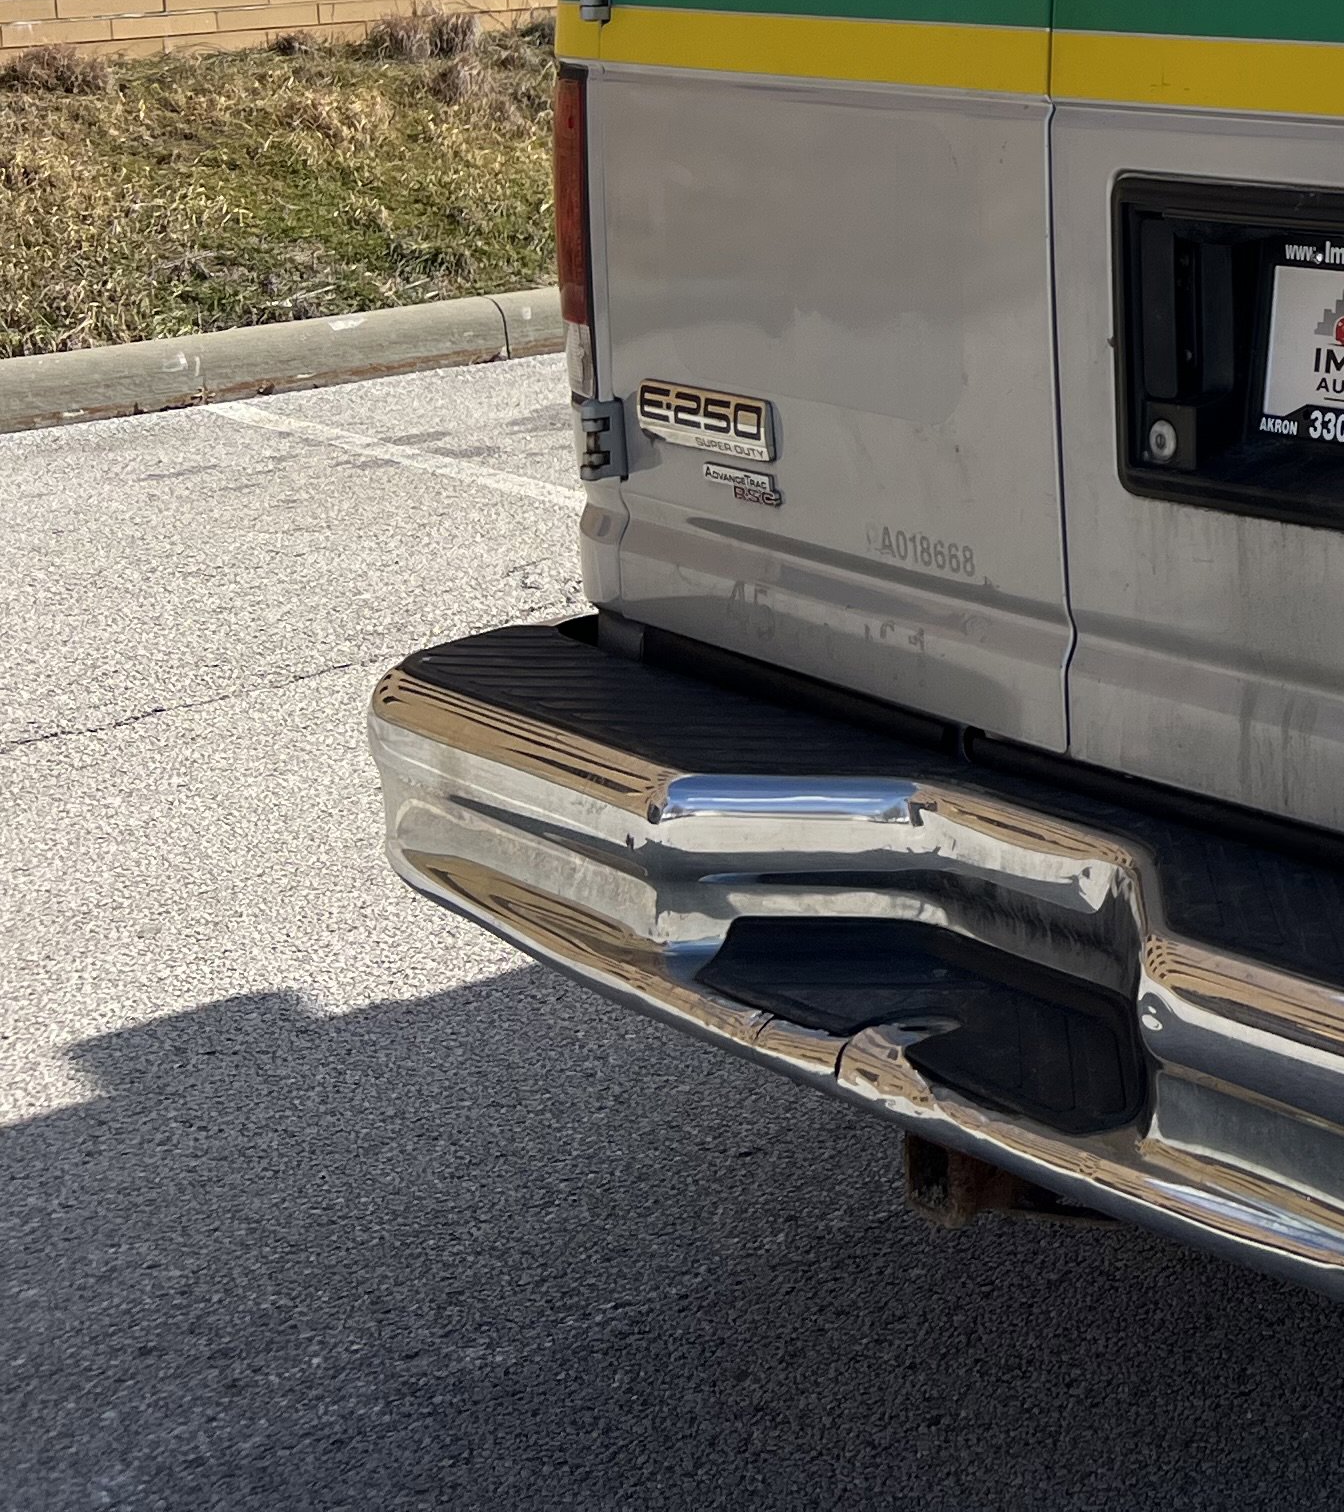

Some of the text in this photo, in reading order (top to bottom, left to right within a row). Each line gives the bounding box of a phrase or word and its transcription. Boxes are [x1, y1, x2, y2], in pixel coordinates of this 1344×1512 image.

[1259, 417, 1298, 435] AKRON
[695, 437, 764, 459] SUPER DUTY
[734, 486, 782, 506] RSC
[879, 525, 976, 577] A018668
